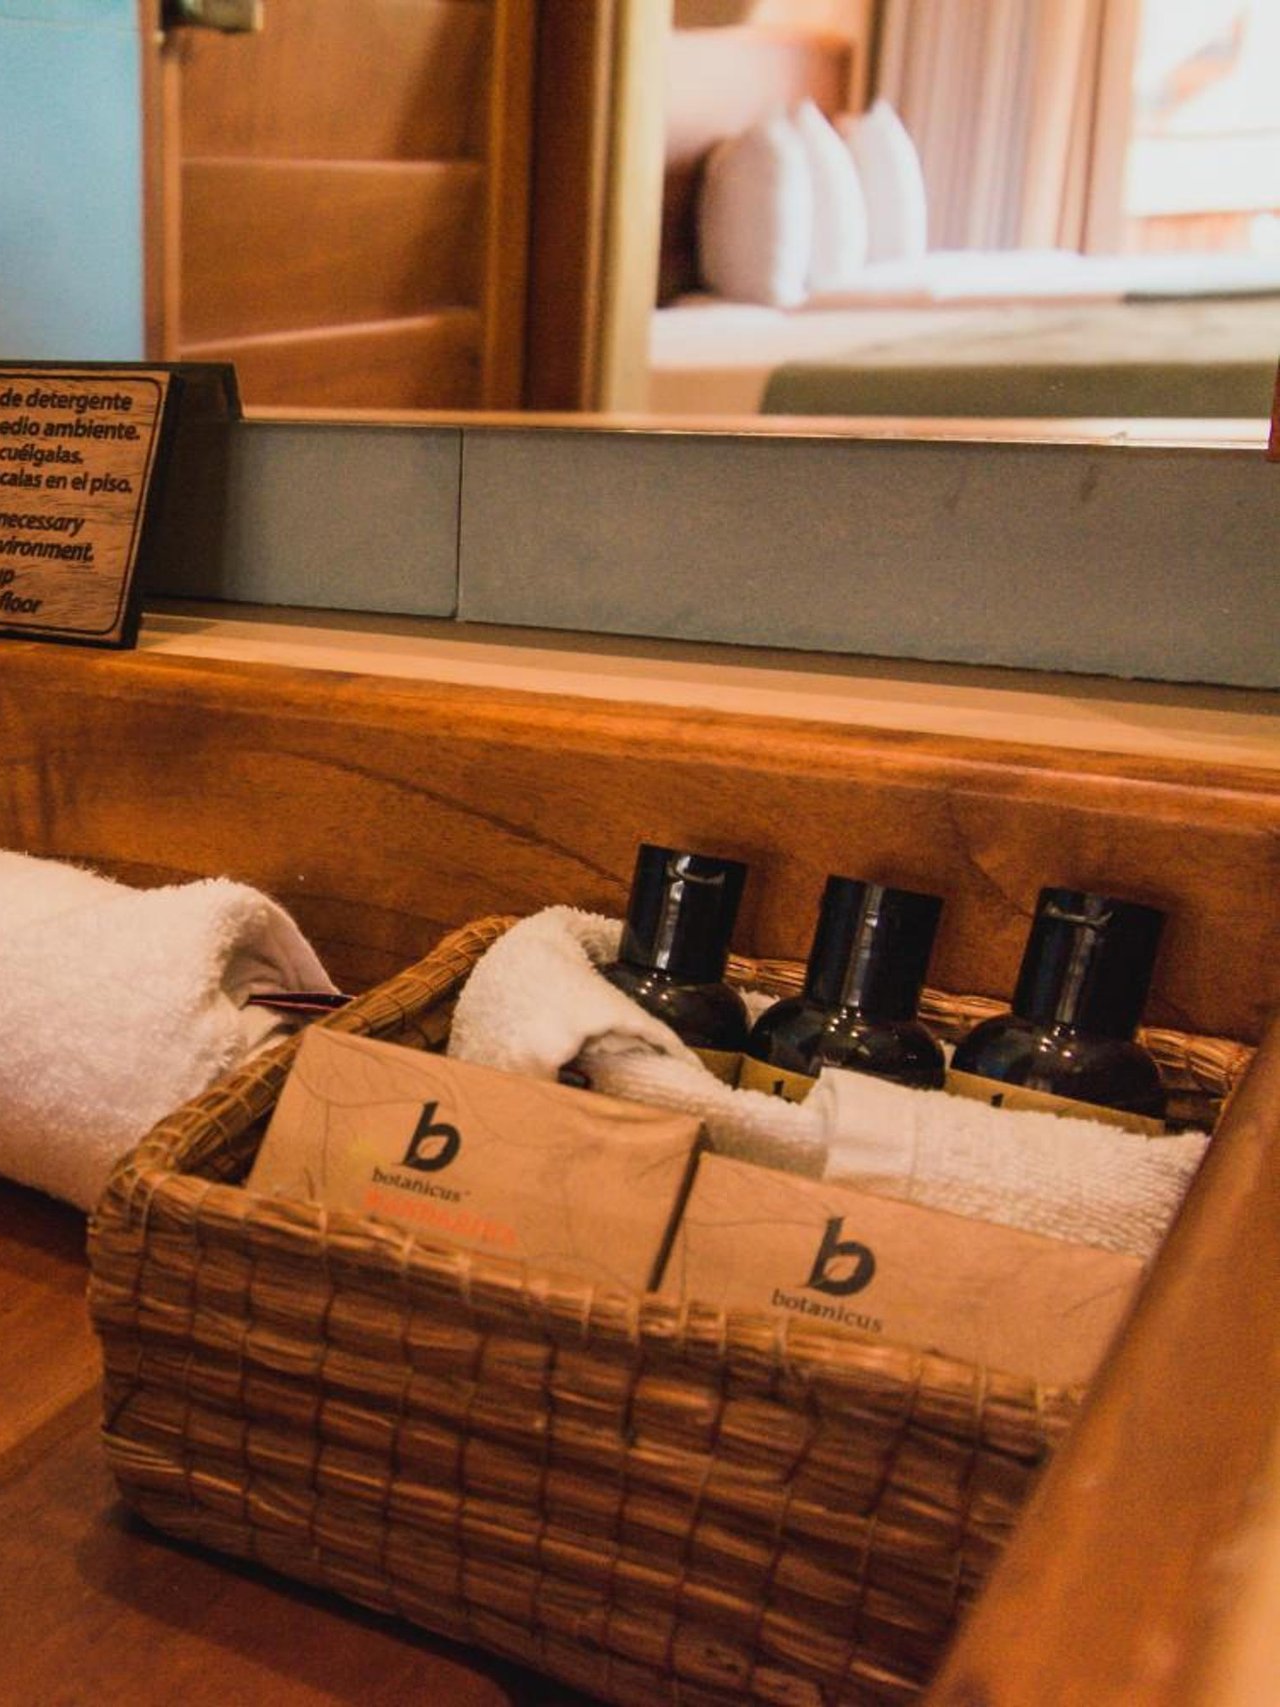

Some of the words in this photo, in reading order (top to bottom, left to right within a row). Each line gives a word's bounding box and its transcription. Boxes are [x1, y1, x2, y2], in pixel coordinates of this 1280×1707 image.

[25, 387, 132, 413] detergente
[43, 418, 140, 441] ambiente.
[45, 476, 68, 489] en
[71, 472, 88, 491] el
[89, 474, 132, 495] piso.
[402, 1100, 461, 1172] b
[807, 1217, 876, 1296] b
[771, 1288, 883, 1333] botanicus
